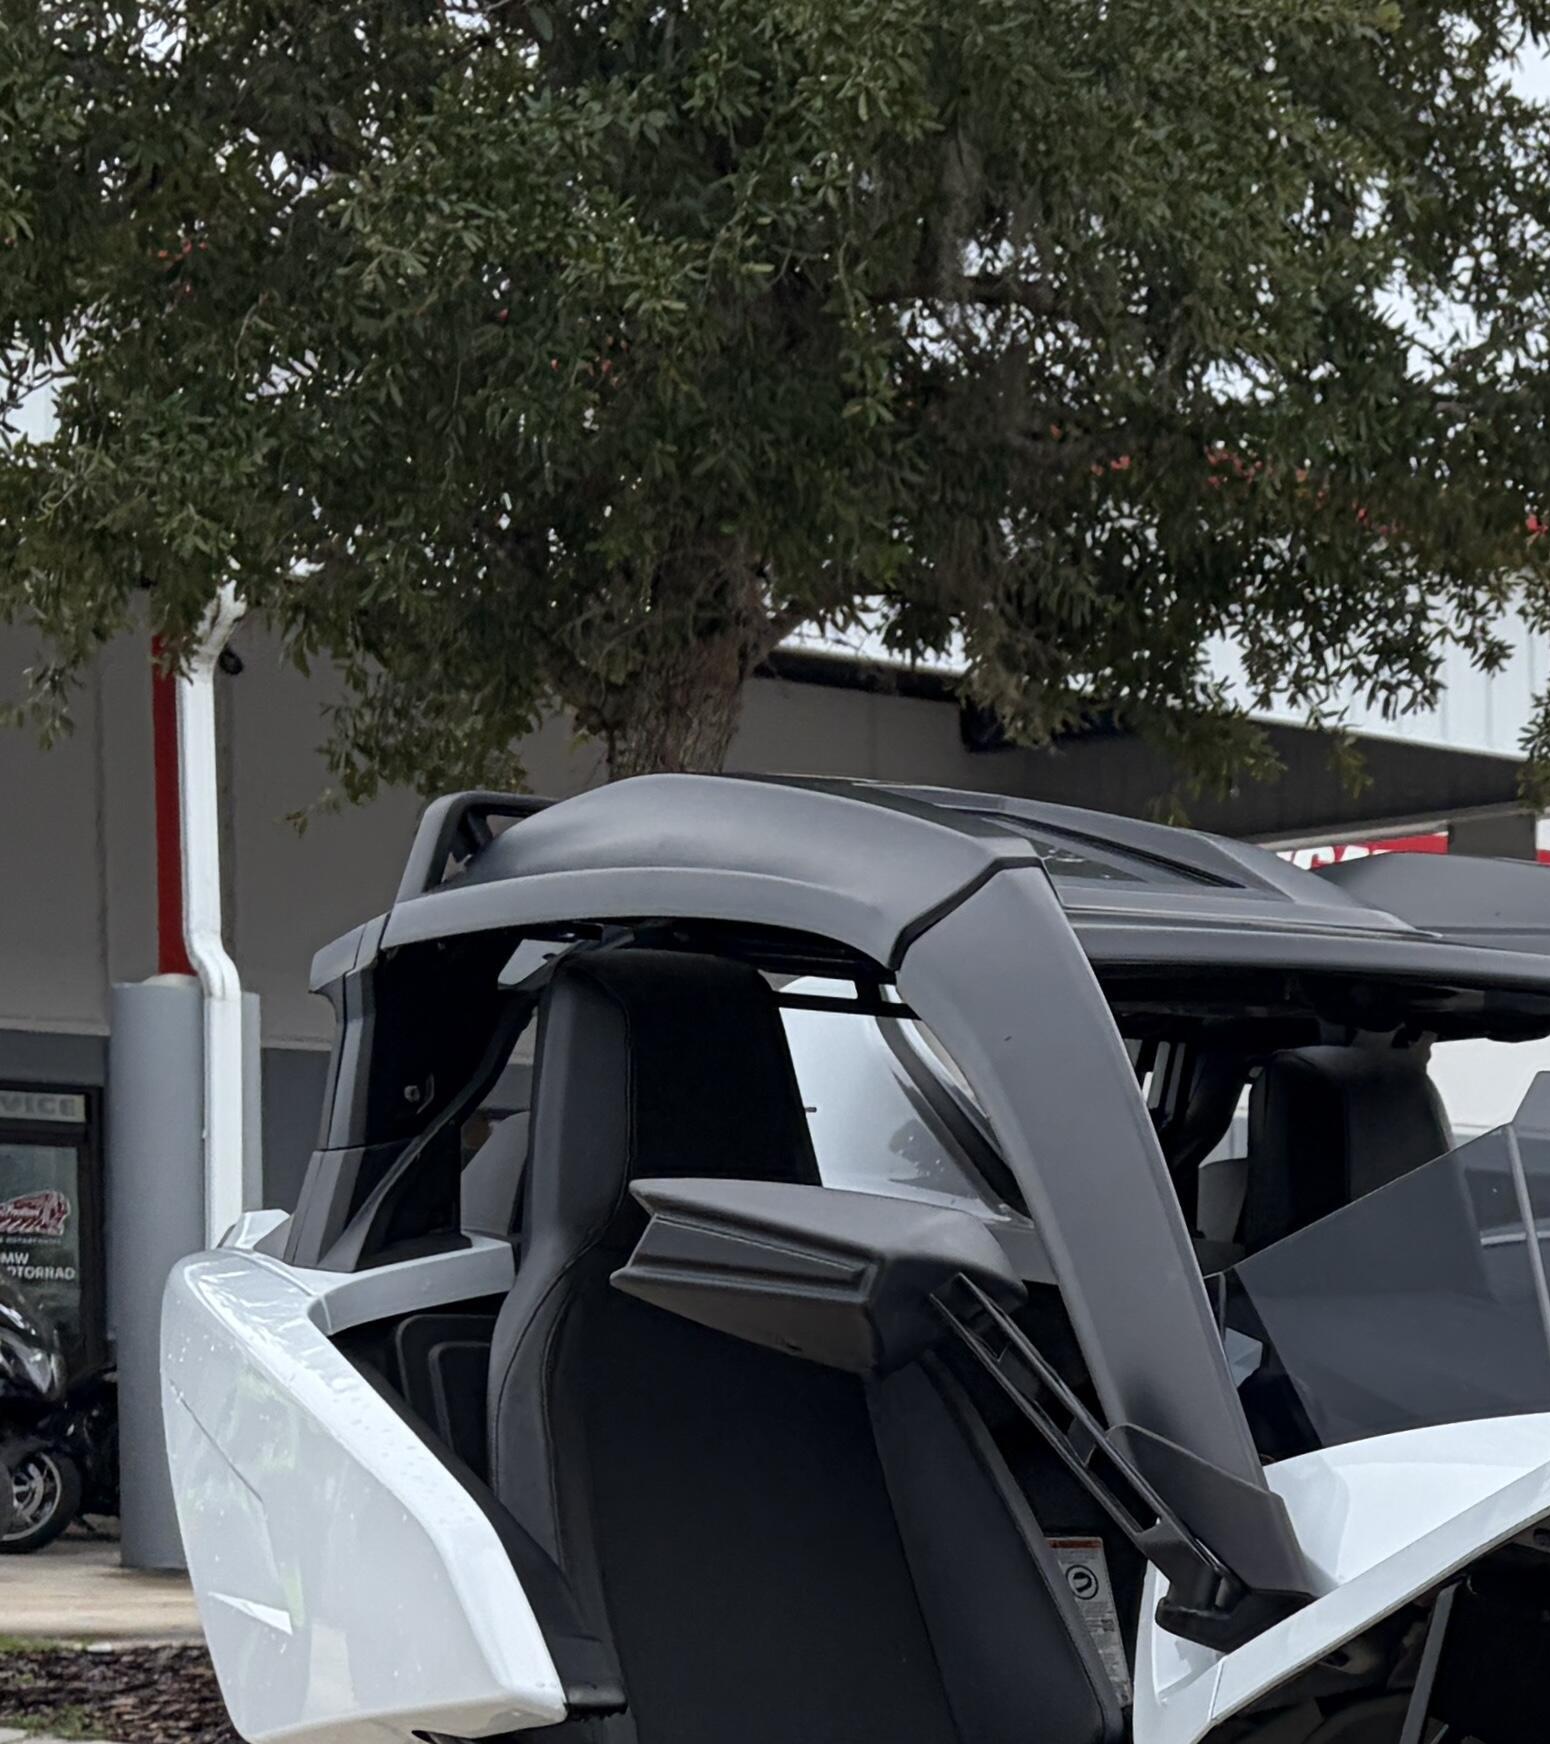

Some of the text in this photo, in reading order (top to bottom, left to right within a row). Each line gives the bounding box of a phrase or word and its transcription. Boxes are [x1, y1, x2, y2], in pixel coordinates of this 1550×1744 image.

[0, 1096, 76, 1116] VICE
[0, 1251, 30, 1266] MW
[6, 1265, 77, 1281] OTORRAD
